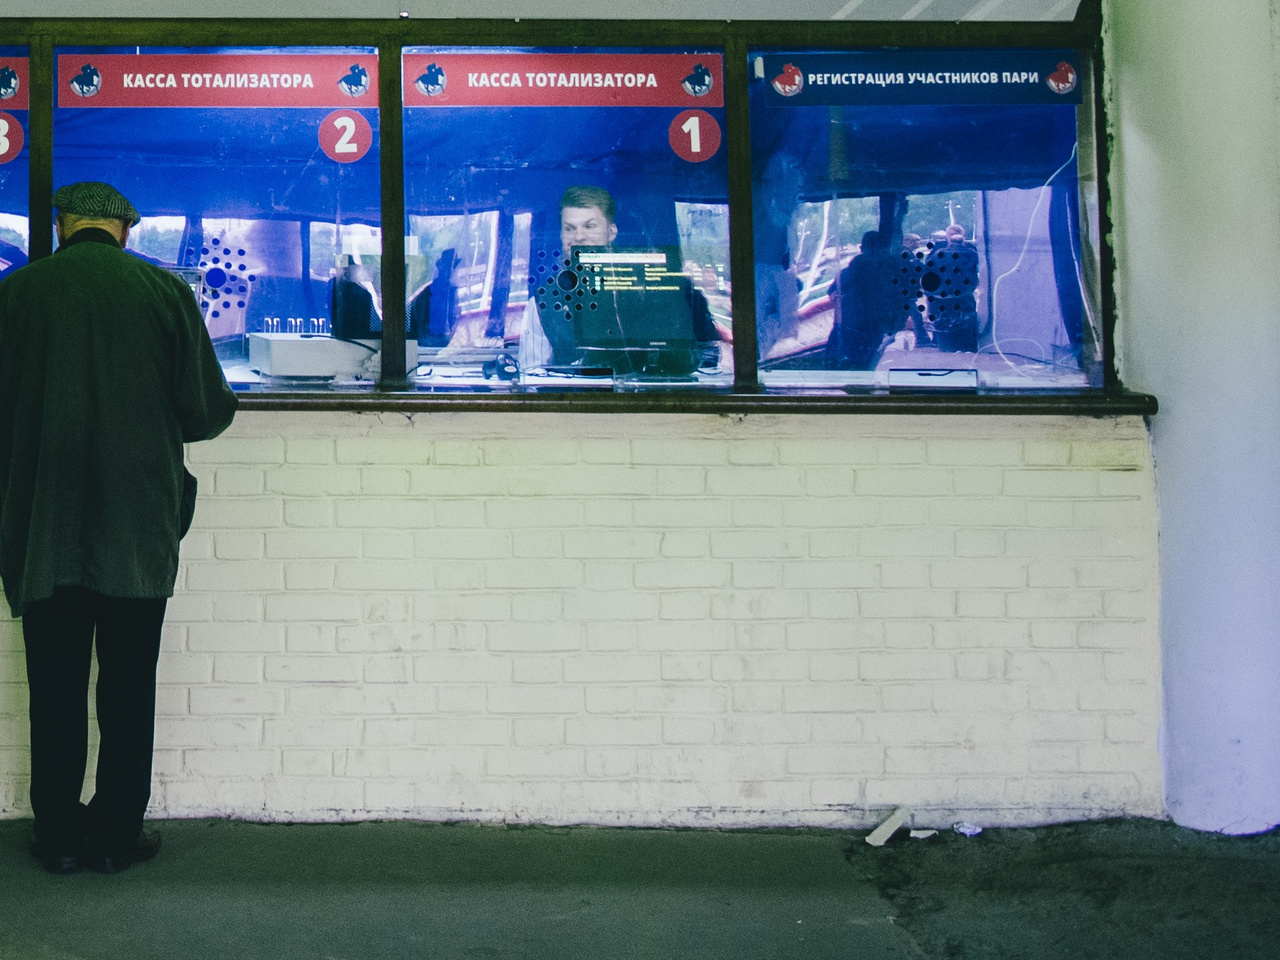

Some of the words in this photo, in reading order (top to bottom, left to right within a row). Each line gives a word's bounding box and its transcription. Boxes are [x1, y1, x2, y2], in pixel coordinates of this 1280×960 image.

[123, 72, 178, 88] КАССА
[181, 72, 315, 89] ТОТАЛИЗАТОРА
[467, 71, 521, 88] КАССА
[525, 71, 658, 89] ТОТАЛИЗАТОРА
[808, 72, 905, 87] РЕГИСТРАЦИЯ
[907, 72, 999, 84] УЧАСТНИКОВ
[1002, 71, 1039, 84] ПАРИ
[333, 115, 358, 154] 2
[681, 116, 701, 153] 1
